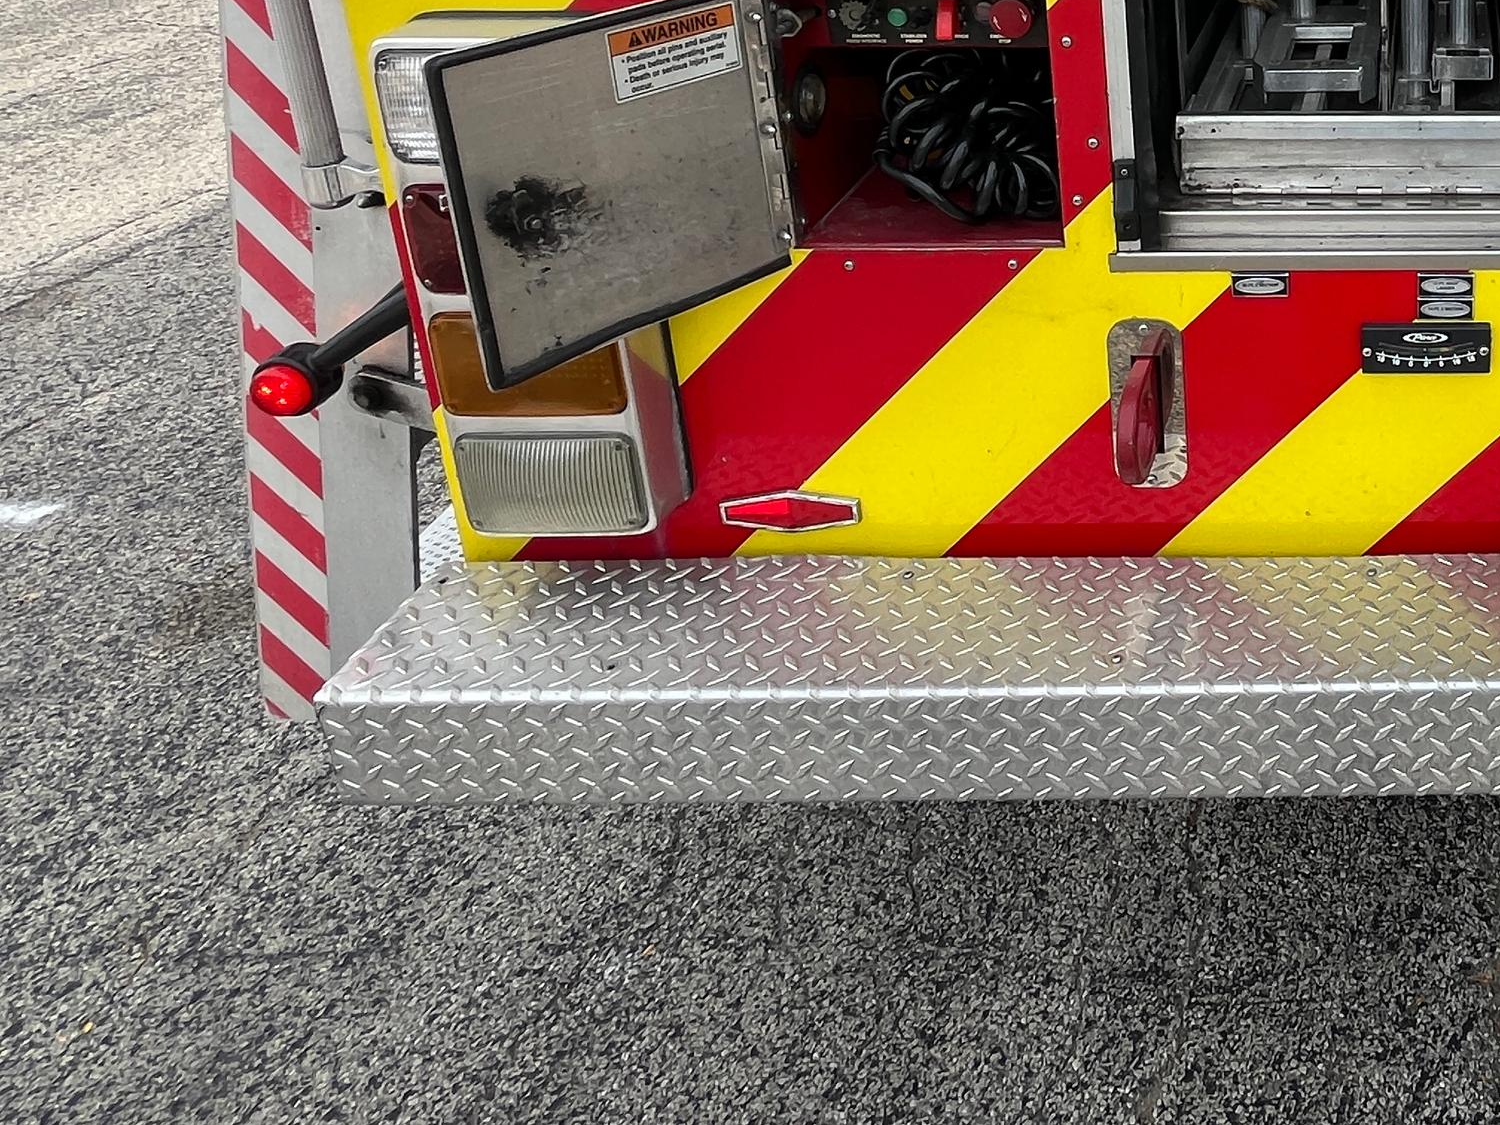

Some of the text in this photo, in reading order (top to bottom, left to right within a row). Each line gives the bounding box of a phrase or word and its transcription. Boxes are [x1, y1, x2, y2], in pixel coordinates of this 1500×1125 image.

[641, 12, 718, 42] WARNING
[626, 32, 727, 63] Position all pins and auxiliary
[628, 63, 646, 75] pads
[648, 57, 670, 68] before
[672, 48, 705, 61] operating
[629, 73, 651, 83] Death
[662, 63, 688, 74] serious
[689, 57, 709, 67] injury
[710, 52, 724, 61] may
